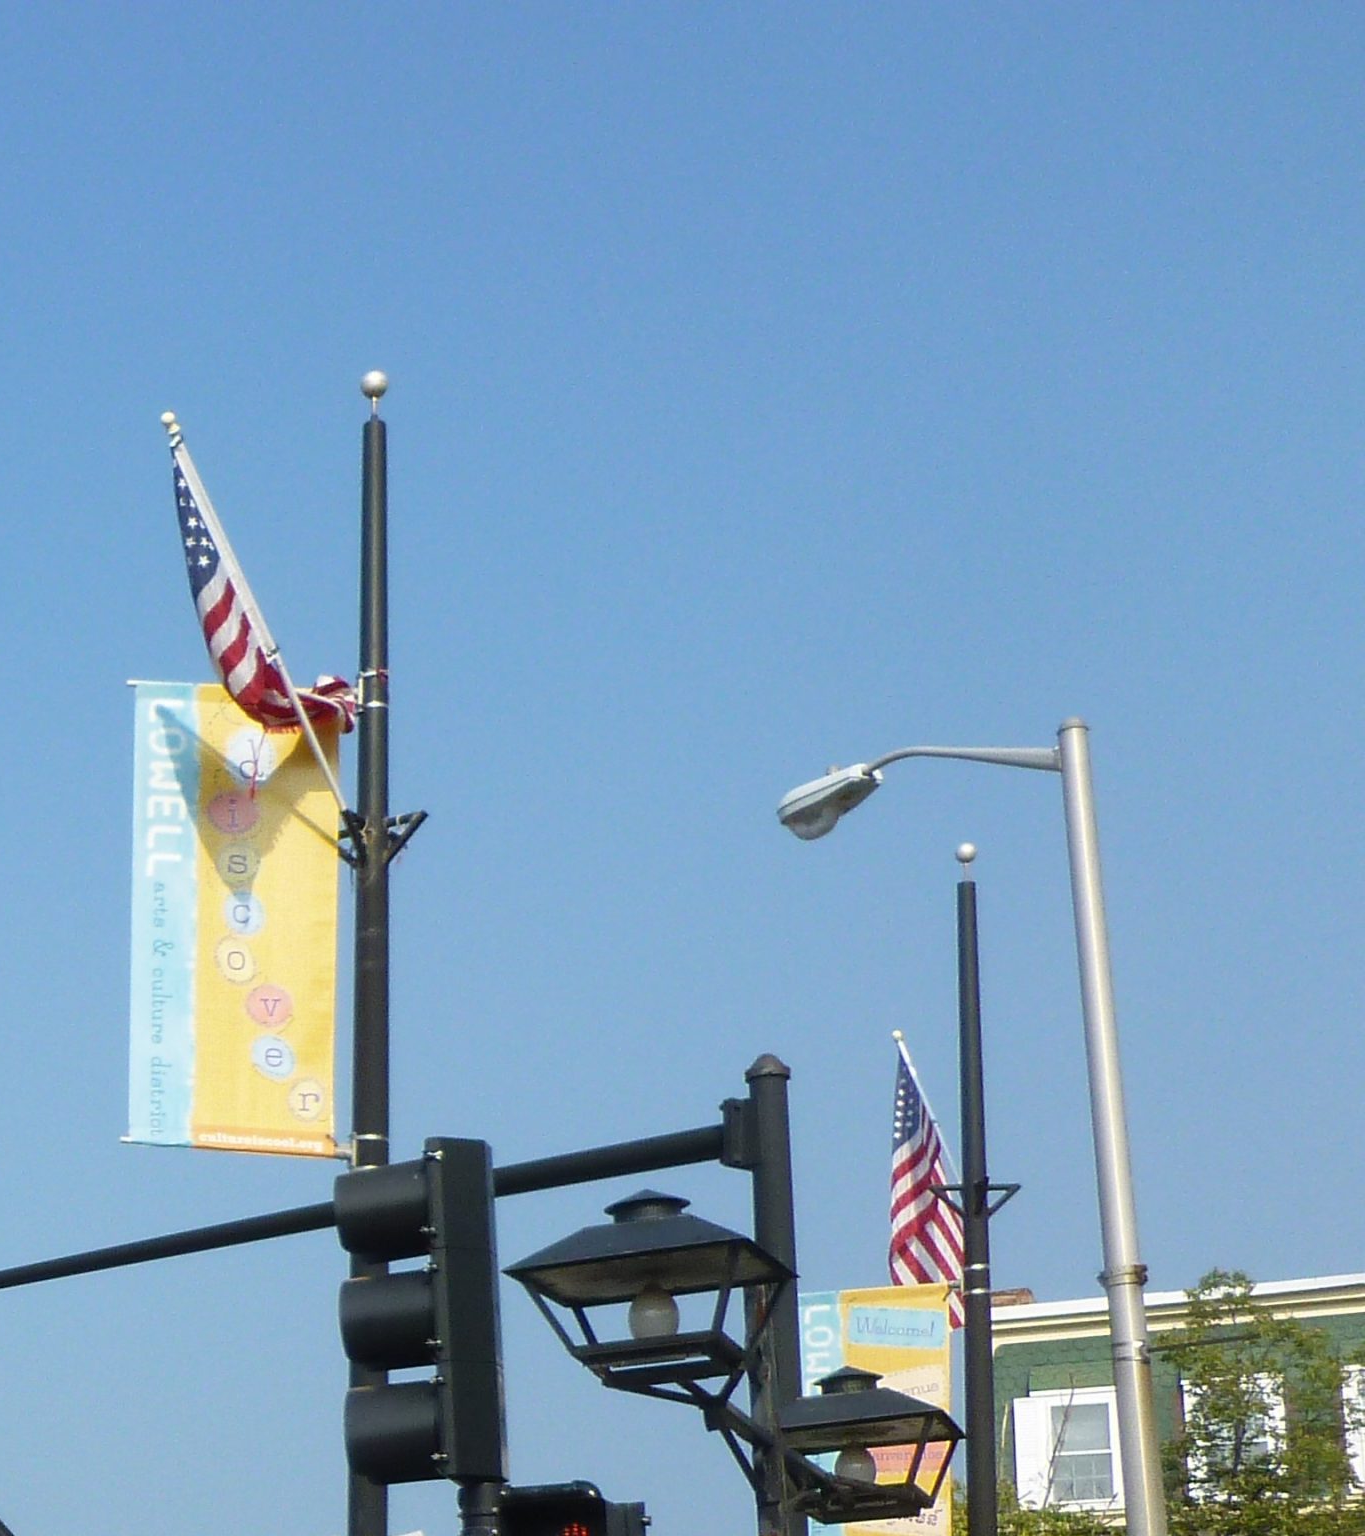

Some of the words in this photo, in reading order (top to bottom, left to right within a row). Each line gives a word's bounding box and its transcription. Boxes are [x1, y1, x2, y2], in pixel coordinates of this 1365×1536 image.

[145, 697, 187, 877] LOWELL
[151, 967, 173, 1045] culture
[149, 1055, 173, 1137] district
[856, 1315, 936, 1337] Welcome!
